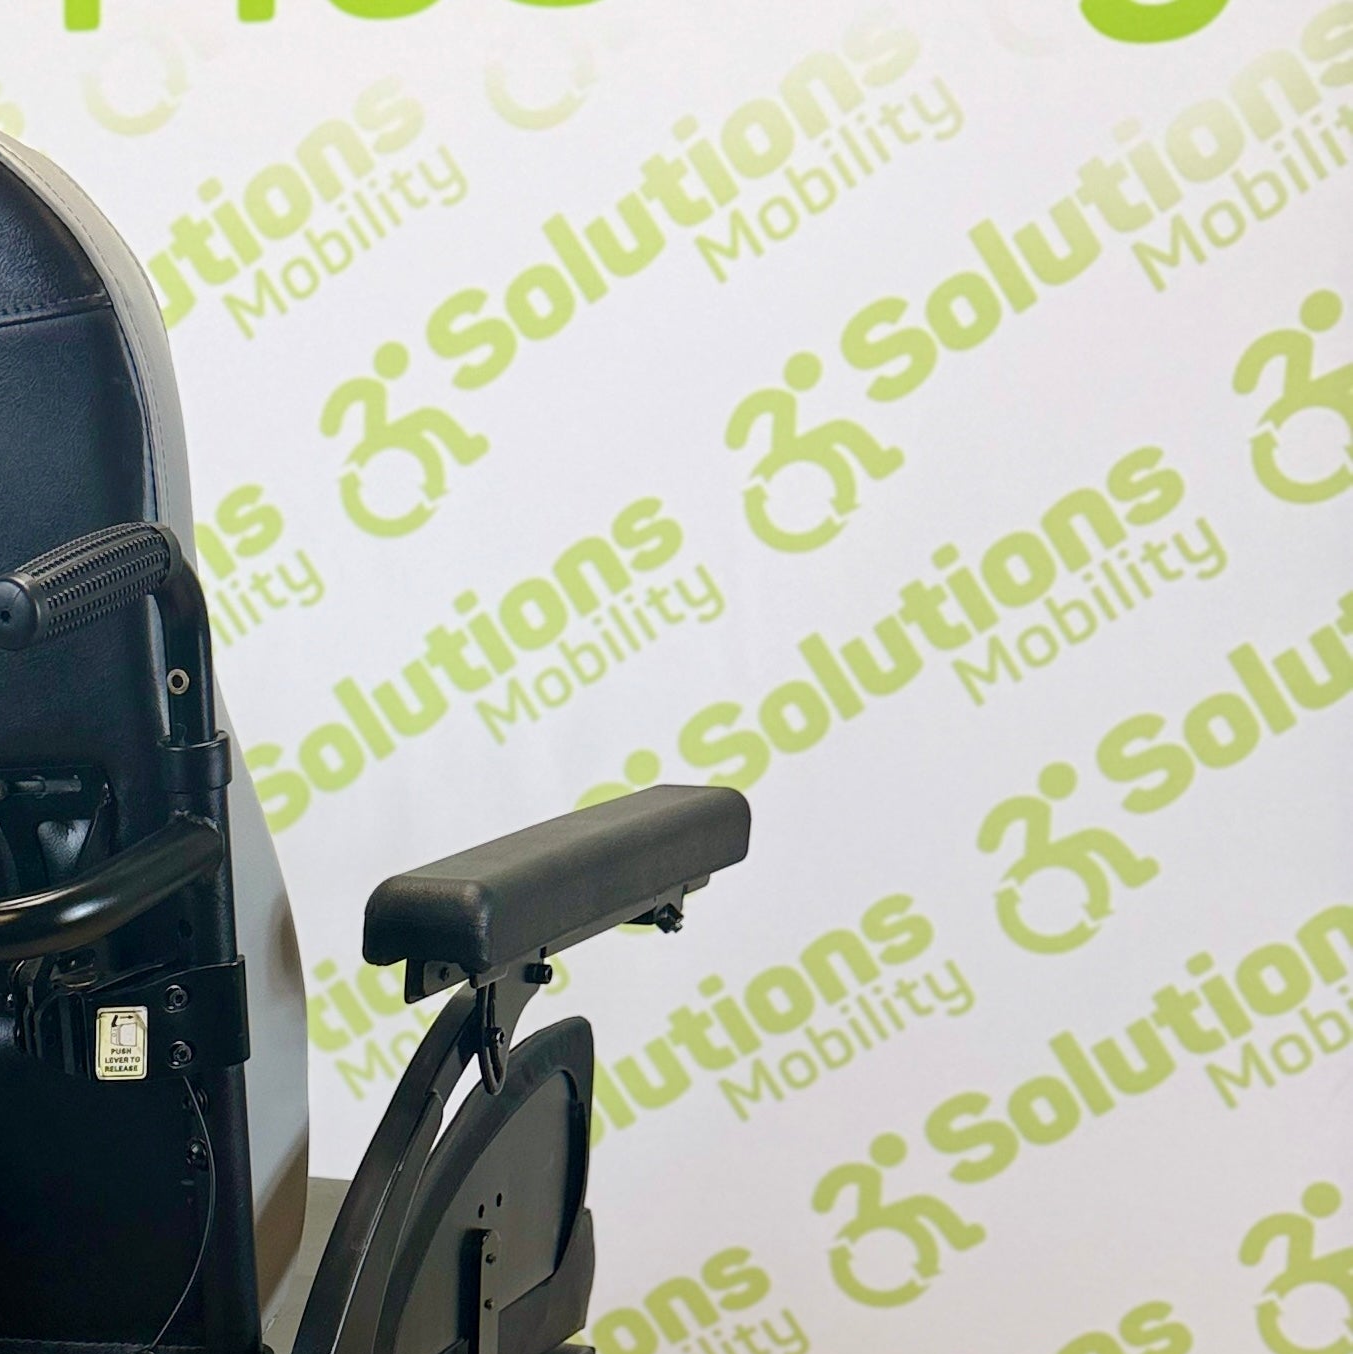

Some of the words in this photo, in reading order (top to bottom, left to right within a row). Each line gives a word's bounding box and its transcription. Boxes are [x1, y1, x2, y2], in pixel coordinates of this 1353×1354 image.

[147, 75, 426, 330] tions
[221, 145, 469, 341] Mobility
[422, 28, 921, 390] Solutions
[693, 77, 964, 284] Mobility
[1130, 104, 1353, 293] Mobili
[244, 498, 684, 835] Solutions
[475, 563, 725, 745] Mobility
[678, 445, 1186, 792] Solutions
[951, 517, 1228, 706] Mobility
[105, 1065, 138, 1073] RELEASE
[589, 893, 934, 1150] lutions
[719, 959, 975, 1122] Mobility
[924, 904, 1353, 1184] Solution
